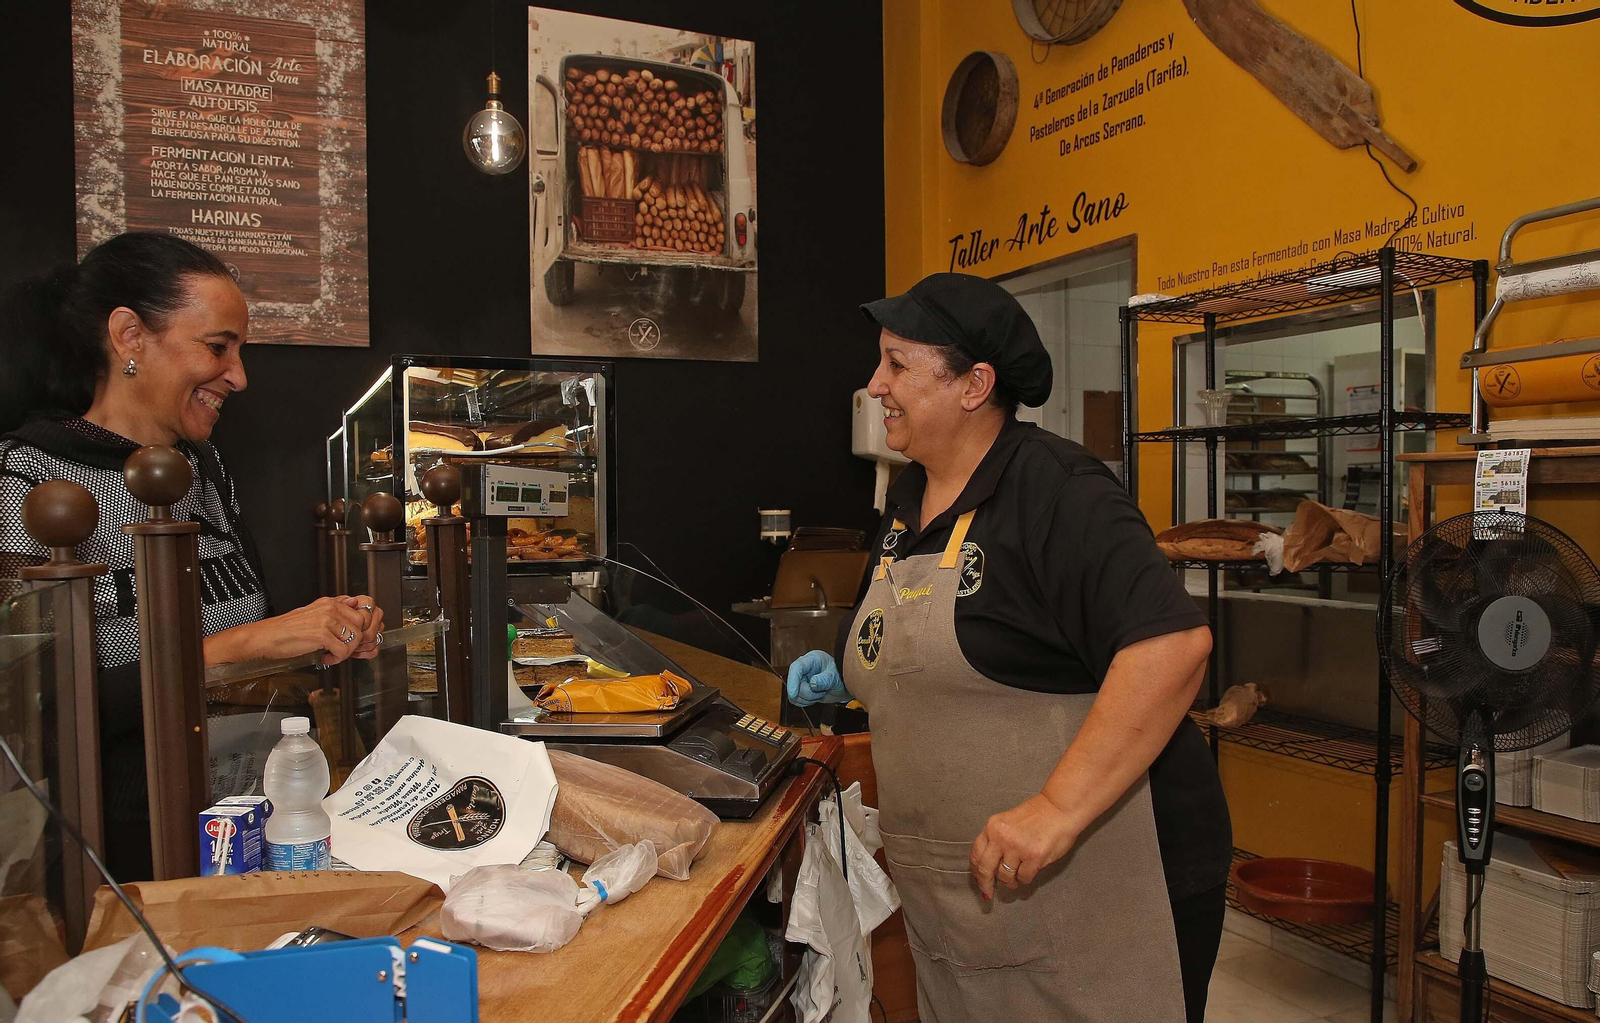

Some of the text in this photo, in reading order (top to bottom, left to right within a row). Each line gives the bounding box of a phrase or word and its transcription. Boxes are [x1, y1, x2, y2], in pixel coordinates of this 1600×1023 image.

[202, 38, 251, 52] NATURAL
[212, 29, 242, 42] 100%
[143, 49, 262, 76] ELABORACIÓN
[266, 57, 302, 72] Arte
[1046, 72, 1094, 105] Generación
[1097, 64, 1109, 82] de
[1111, 40, 1165, 75] Panaderos
[1168, 32, 1174, 49] y
[266, 70, 299, 85] Sana
[184, 79, 270, 98] MASA MADRE
[189, 95, 260, 113] AUTOLISIS.
[1030, 112, 1075, 143] Pasteleros
[1102, 80, 1144, 112] Zarzuela
[1146, 56, 1190, 92] (Tarifa).
[151, 108, 177, 119] SIRVE
[180, 110, 204, 121] PARA
[206, 114, 228, 124] QUE
[230, 116, 241, 124] LA
[291, 123, 302, 131] DE
[151, 118, 299, 139] GLUTEN DESARROLLE DE MANERA
[151, 128, 210, 140] BENEFICIOSA
[212, 132, 236, 142] PARA
[238, 135, 250, 144] SU
[1060, 114, 1146, 157] De Arcos Serrano.
[150, 160, 190, 171] APORTA
[193, 163, 226, 174] SABOR,
[228, 166, 259, 176] AROMA
[251, 154, 294, 168] LENTA:
[150, 170, 176, 180] HACE
[178, 172, 199, 182] QUE
[202, 174, 212, 182] EL
[215, 174, 233, 184] PAN
[234, 176, 253, 186] SEA
[276, 180, 300, 190] SANO
[151, 189, 164, 198] LA
[238, 194, 282, 206] NATURAL.
[209, 184, 270, 196] COMPLETADO
[191, 208, 262, 228] HARINAS
[168, 226, 194, 235] TODAS
[195, 228, 235, 238] NUESTRAS
[236, 230, 267, 239] HARINAS
[949, 192, 1130, 272] Taller Arte Sano
[1427, 222, 1478, 249] Natural.
[228, 238, 257, 246] MANERA
[239, 246, 260, 254] MODO
[262, 246, 308, 257] TRADICIONAL.
[1157, 275, 1176, 291] Todo
[1178, 268, 1210, 286] Nuestro
[1212, 262, 1228, 278] Pan
[1230, 258, 1250, 273] esta
[1252, 241, 1308, 267] Fermentado
[1312, 237, 1330, 252] con
[1334, 229, 1361, 246] Masa
[1366, 217, 1400, 239] Madre
[1422, 203, 1464, 226] Cultivo
[406, 758, 425, 782] Harina
[385, 782, 406, 802] molida
[401, 781, 422, 800] Masa
[418, 776, 435, 795] horas
[420, 783, 440, 802] 100%
[476, 818, 500, 841] HORNO
